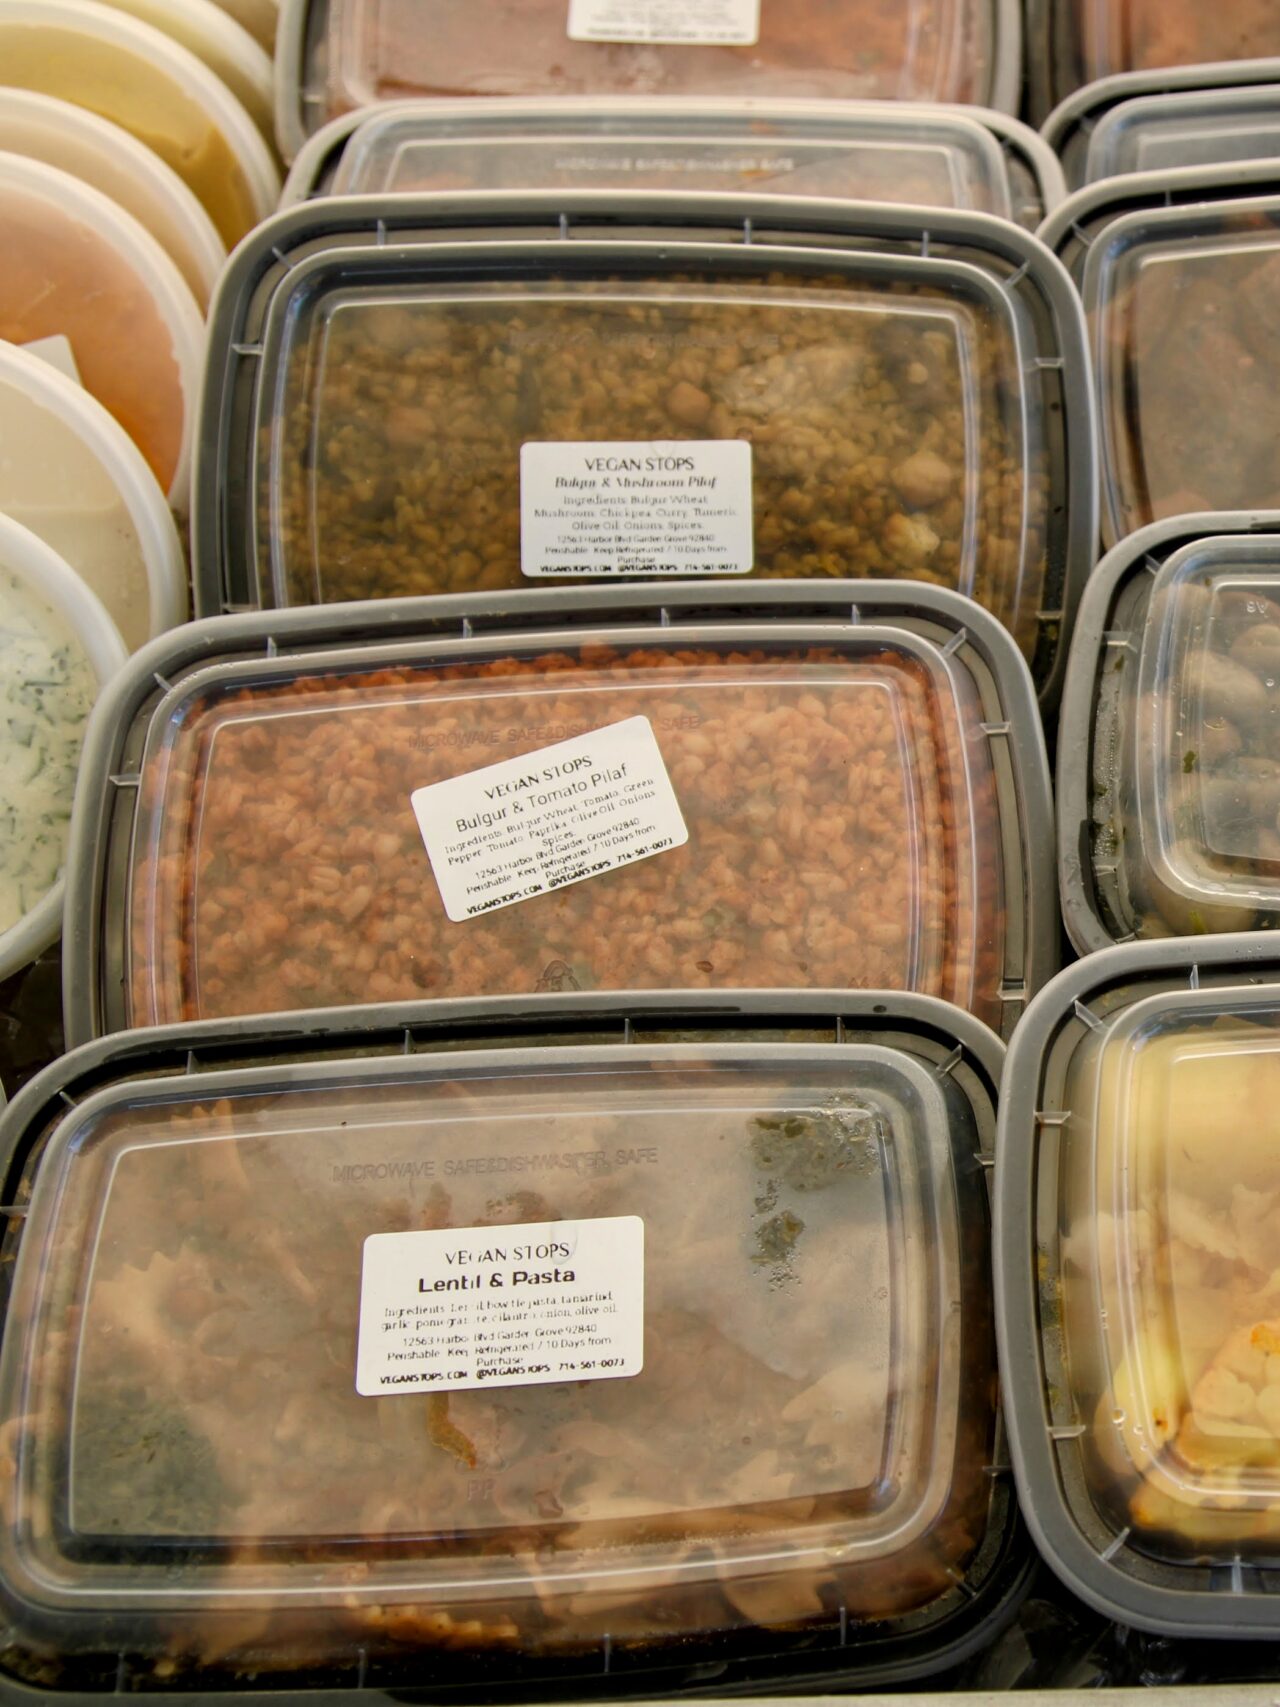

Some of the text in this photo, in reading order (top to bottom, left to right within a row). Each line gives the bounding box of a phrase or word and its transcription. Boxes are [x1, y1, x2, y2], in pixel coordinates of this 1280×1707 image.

[585, 456, 695, 471] VEGAN STOPS
[409, 716, 700, 749] MICROWAVE SAFE
[484, 755, 593, 800] VEGAN STOPS
[456, 763, 628, 833] Bulgur & Tomato Pilaf
[613, 817, 640, 832] 92840
[612, 833, 634, 846] Days
[333, 1160, 435, 1183] MICROWAVE
[615, 1147, 659, 1165] SAFE
[445, 1242, 570, 1265] VEGAN STOPS
[418, 1267, 576, 1294] Lentil & Pasta
[575, 1305, 599, 1316] olive
[403, 1336, 434, 1347] 12563
[535, 1327, 564, 1337] Grove
[565, 1324, 597, 1334] 92840
[561, 1339, 585, 1349] Days
[588, 1336, 612, 1346] from
[476, 1356, 524, 1366] Purchase
[559, 1357, 625, 1370] 714-561-0073
